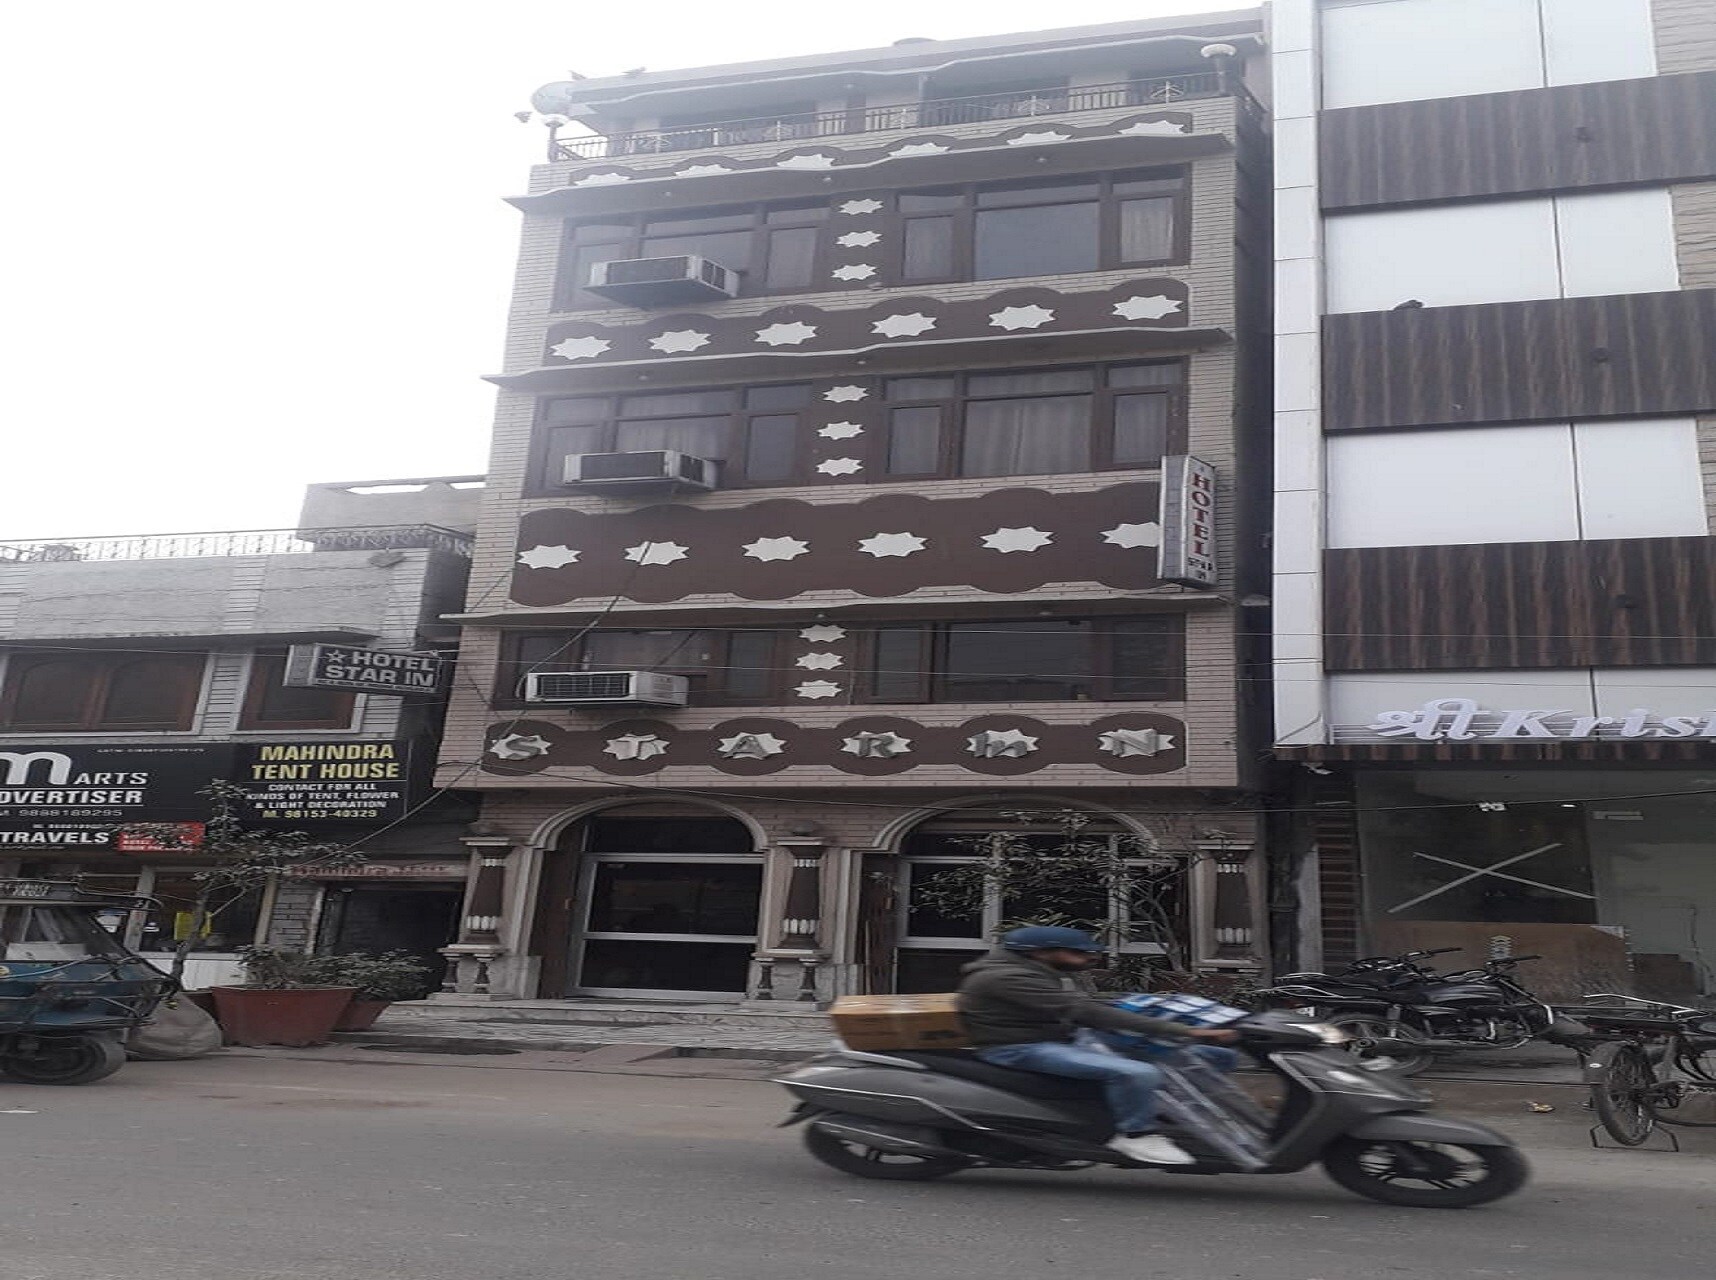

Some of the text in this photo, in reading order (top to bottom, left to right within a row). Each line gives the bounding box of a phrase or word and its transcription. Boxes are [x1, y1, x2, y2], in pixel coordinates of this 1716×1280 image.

[1191, 472, 1211, 557] HOTEL
[352, 651, 434, 671] HOTEL
[325, 664, 396, 683] STAR
[1492, 708, 1716, 738] Kris
[260, 744, 395, 760] MAHINDRA
[73, 772, 149, 785] ARTS
[252, 762, 400, 780] TENT HOUSE
[307, 801, 387, 809] DECORATION
[0, 831, 110, 843] TRAVELS
